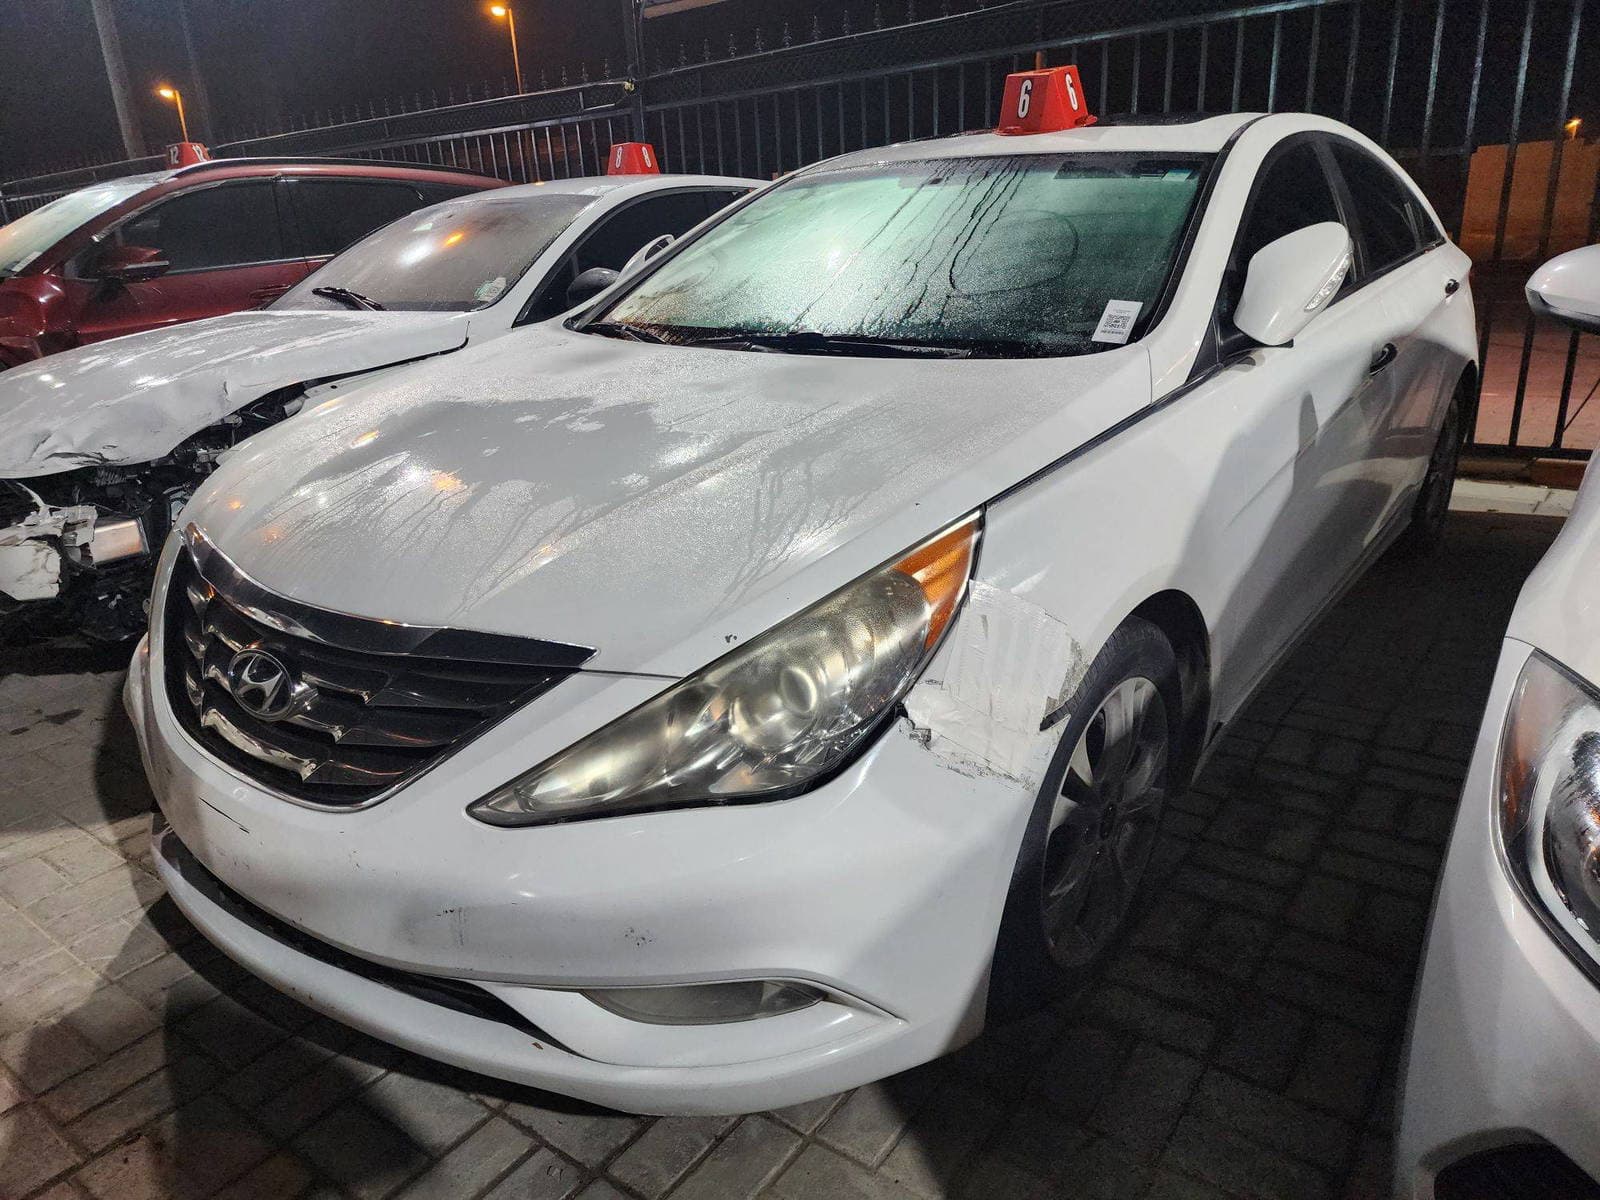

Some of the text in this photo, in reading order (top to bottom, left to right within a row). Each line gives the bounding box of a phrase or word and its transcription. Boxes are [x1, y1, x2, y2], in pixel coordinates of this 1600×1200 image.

[1017, 79, 1033, 118] 6
[1065, 73, 1079, 111] 6
[169, 146, 179, 165] 12
[192, 144, 207, 162] 12
[615, 146, 623, 168] 8
[641, 146, 652, 168] 8
